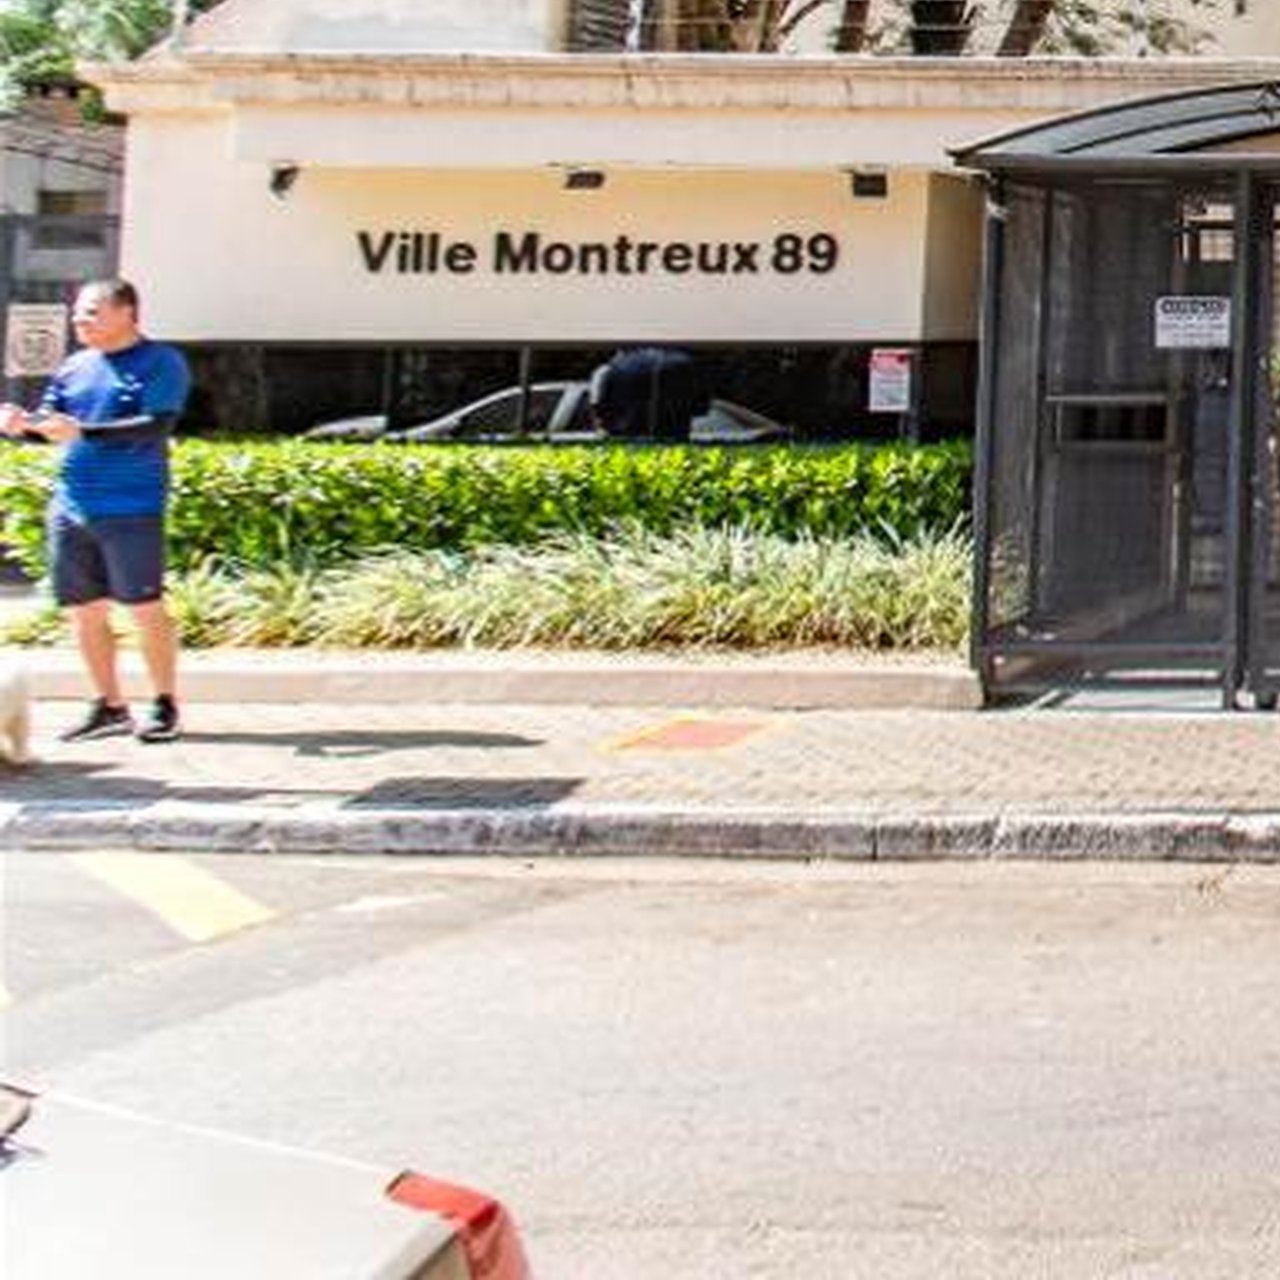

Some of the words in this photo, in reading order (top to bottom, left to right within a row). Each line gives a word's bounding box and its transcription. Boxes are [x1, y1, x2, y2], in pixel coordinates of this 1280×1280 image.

[357, 230, 478, 275] Ville
[492, 230, 760, 276] Montreux
[770, 231, 839, 276] 89
